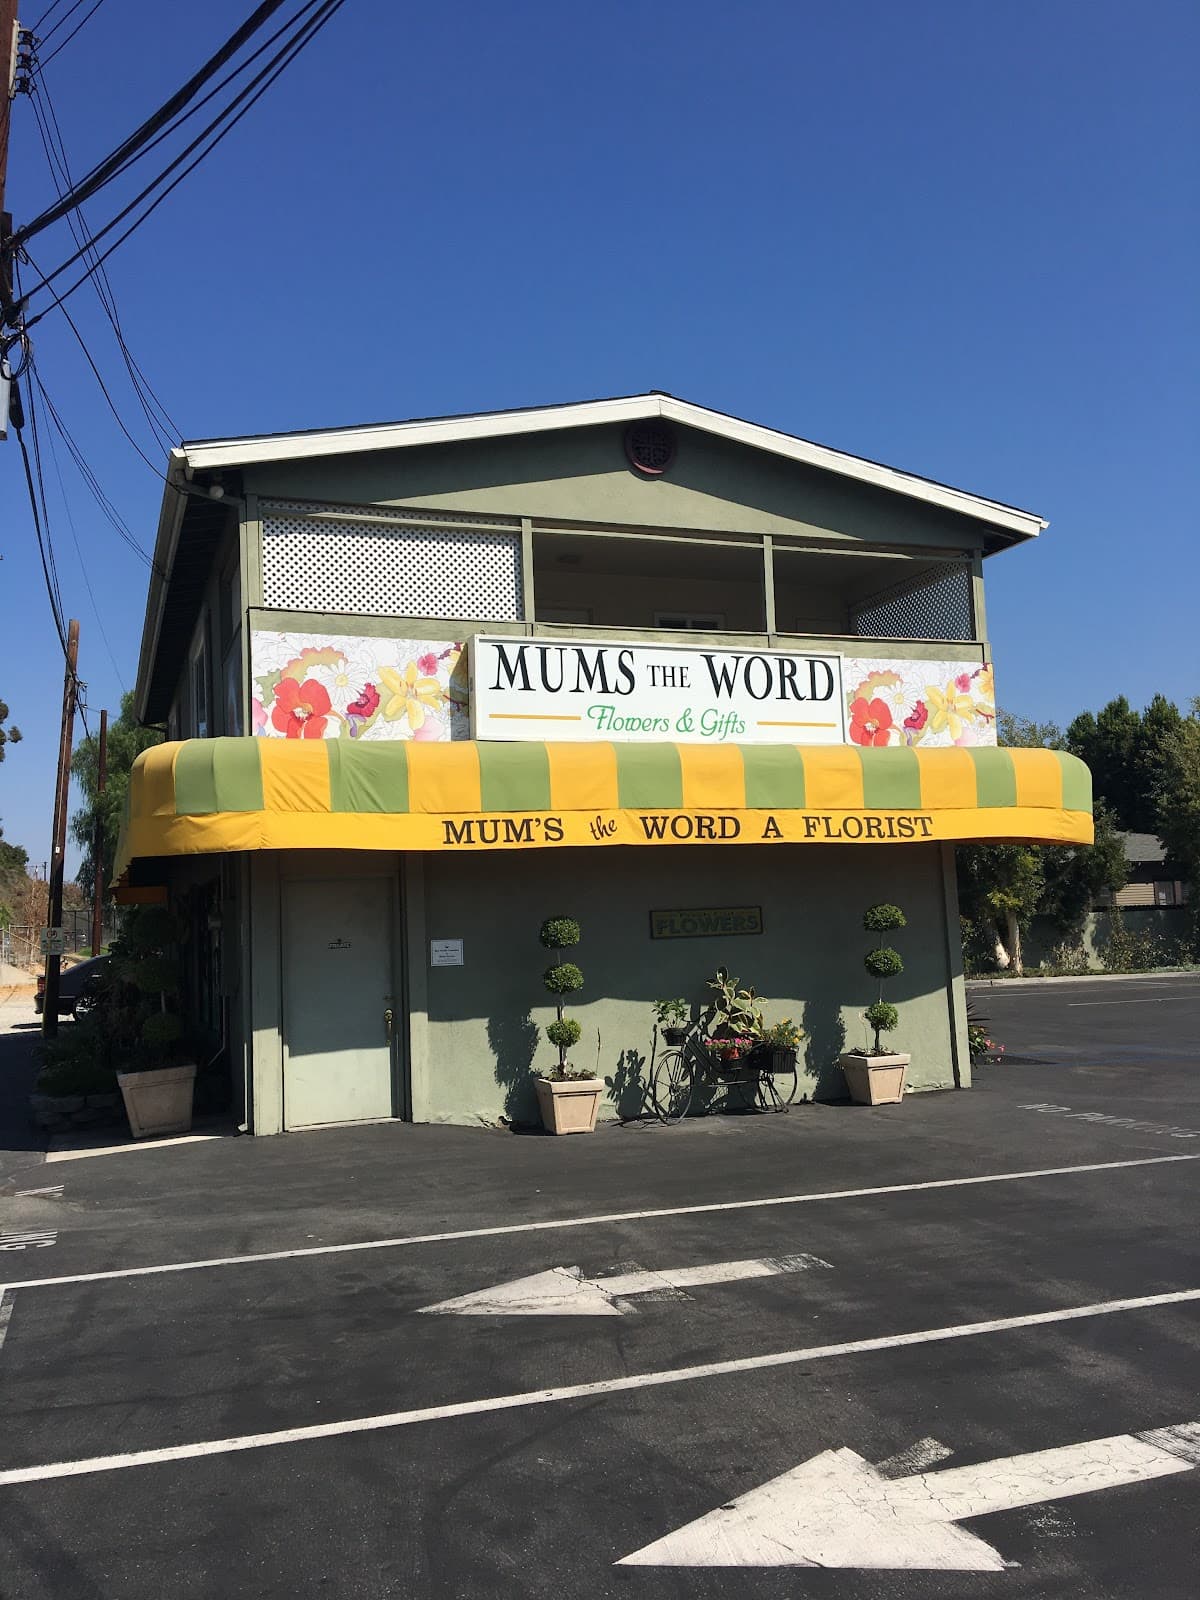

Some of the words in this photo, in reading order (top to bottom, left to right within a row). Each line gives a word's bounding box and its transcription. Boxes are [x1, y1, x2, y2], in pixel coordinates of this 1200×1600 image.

[488, 643, 637, 696] MUMS
[646, 664, 691, 689] THE
[700, 653, 836, 702] WORD
[587, 704, 670, 733] Flowers
[676, 708, 695, 733] &
[700, 708, 746, 741] Gifts
[442, 817, 565, 845] MUM'S
[590, 815, 618, 841] the
[640, 815, 741, 840] WORD
[761, 816, 784, 839] A
[803, 816, 933, 839] FLORIST
[655, 912, 759, 935] FLOWERS
